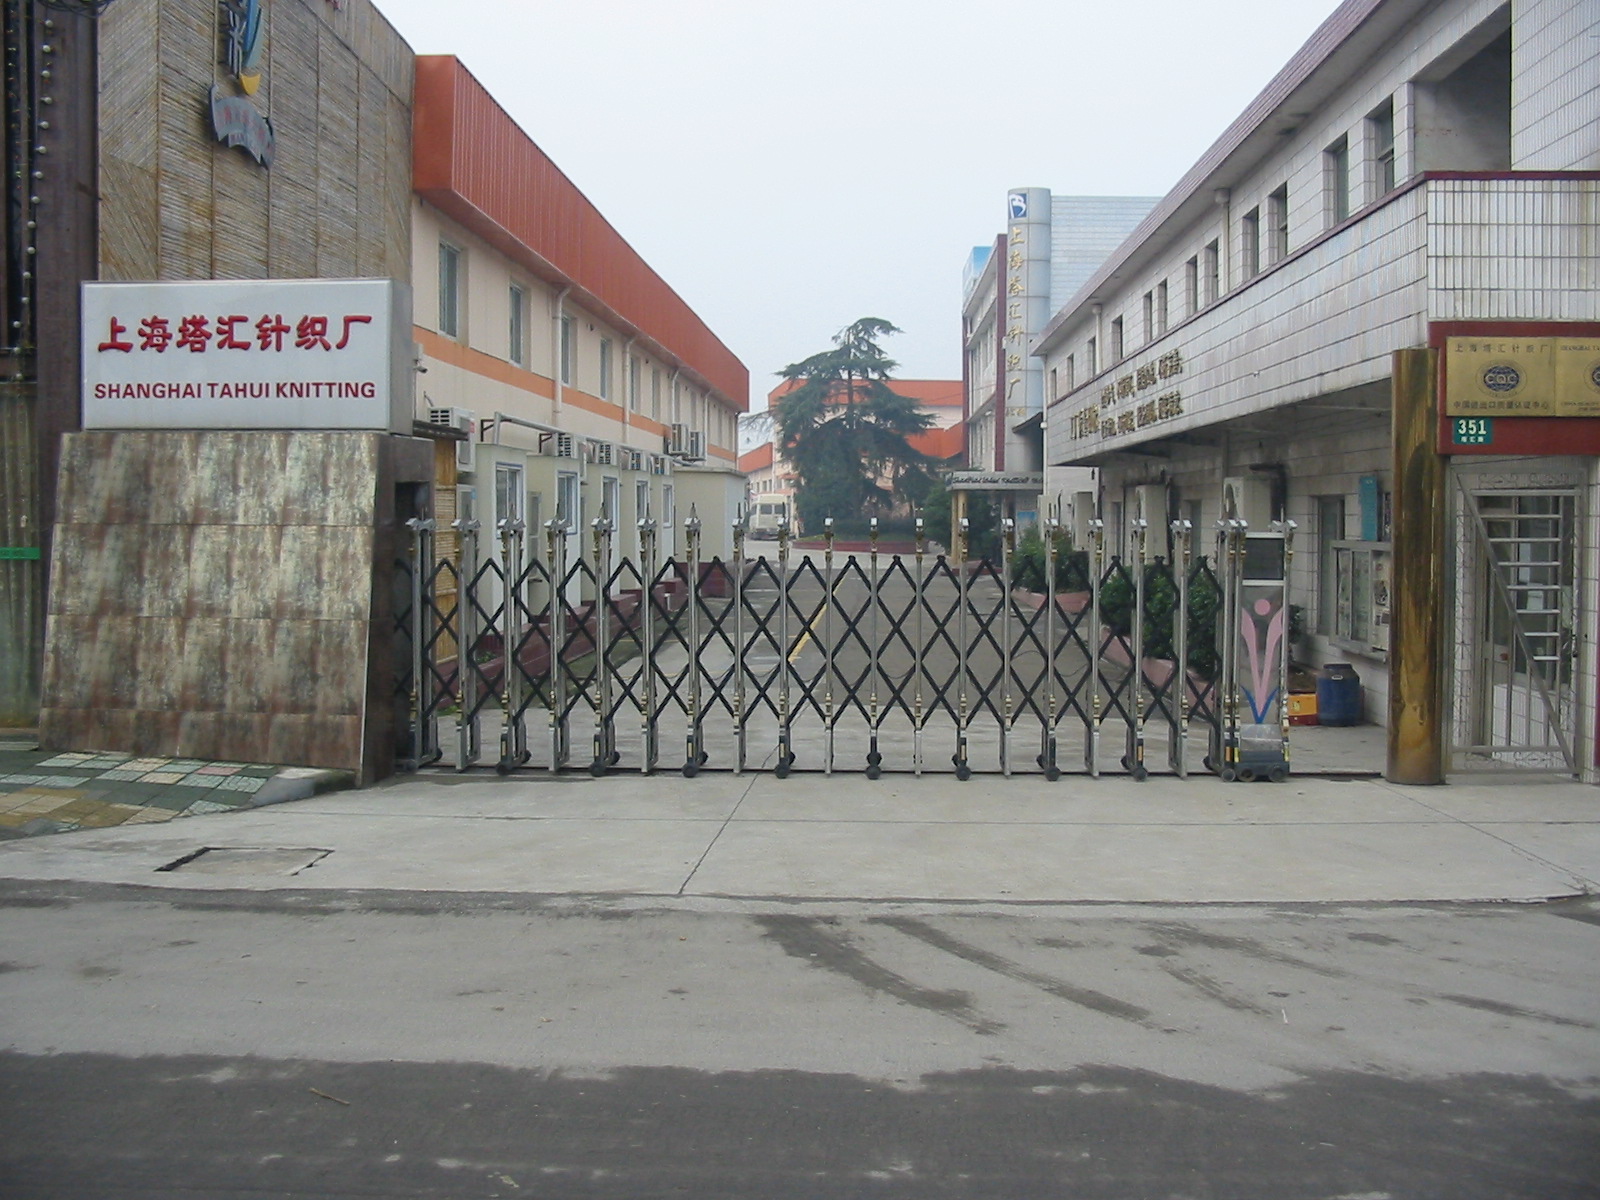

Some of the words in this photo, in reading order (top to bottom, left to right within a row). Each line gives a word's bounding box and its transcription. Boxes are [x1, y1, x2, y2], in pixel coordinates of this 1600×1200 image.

[97, 314, 373, 354] 上海塔汇针织厂
[1485, 373, 1518, 384] CQC
[94, 383, 201, 399] SHANGHAI
[207, 382, 270, 399] TAHUI
[276, 381, 376, 398] KNITTING
[1458, 419, 1487, 435] 351
